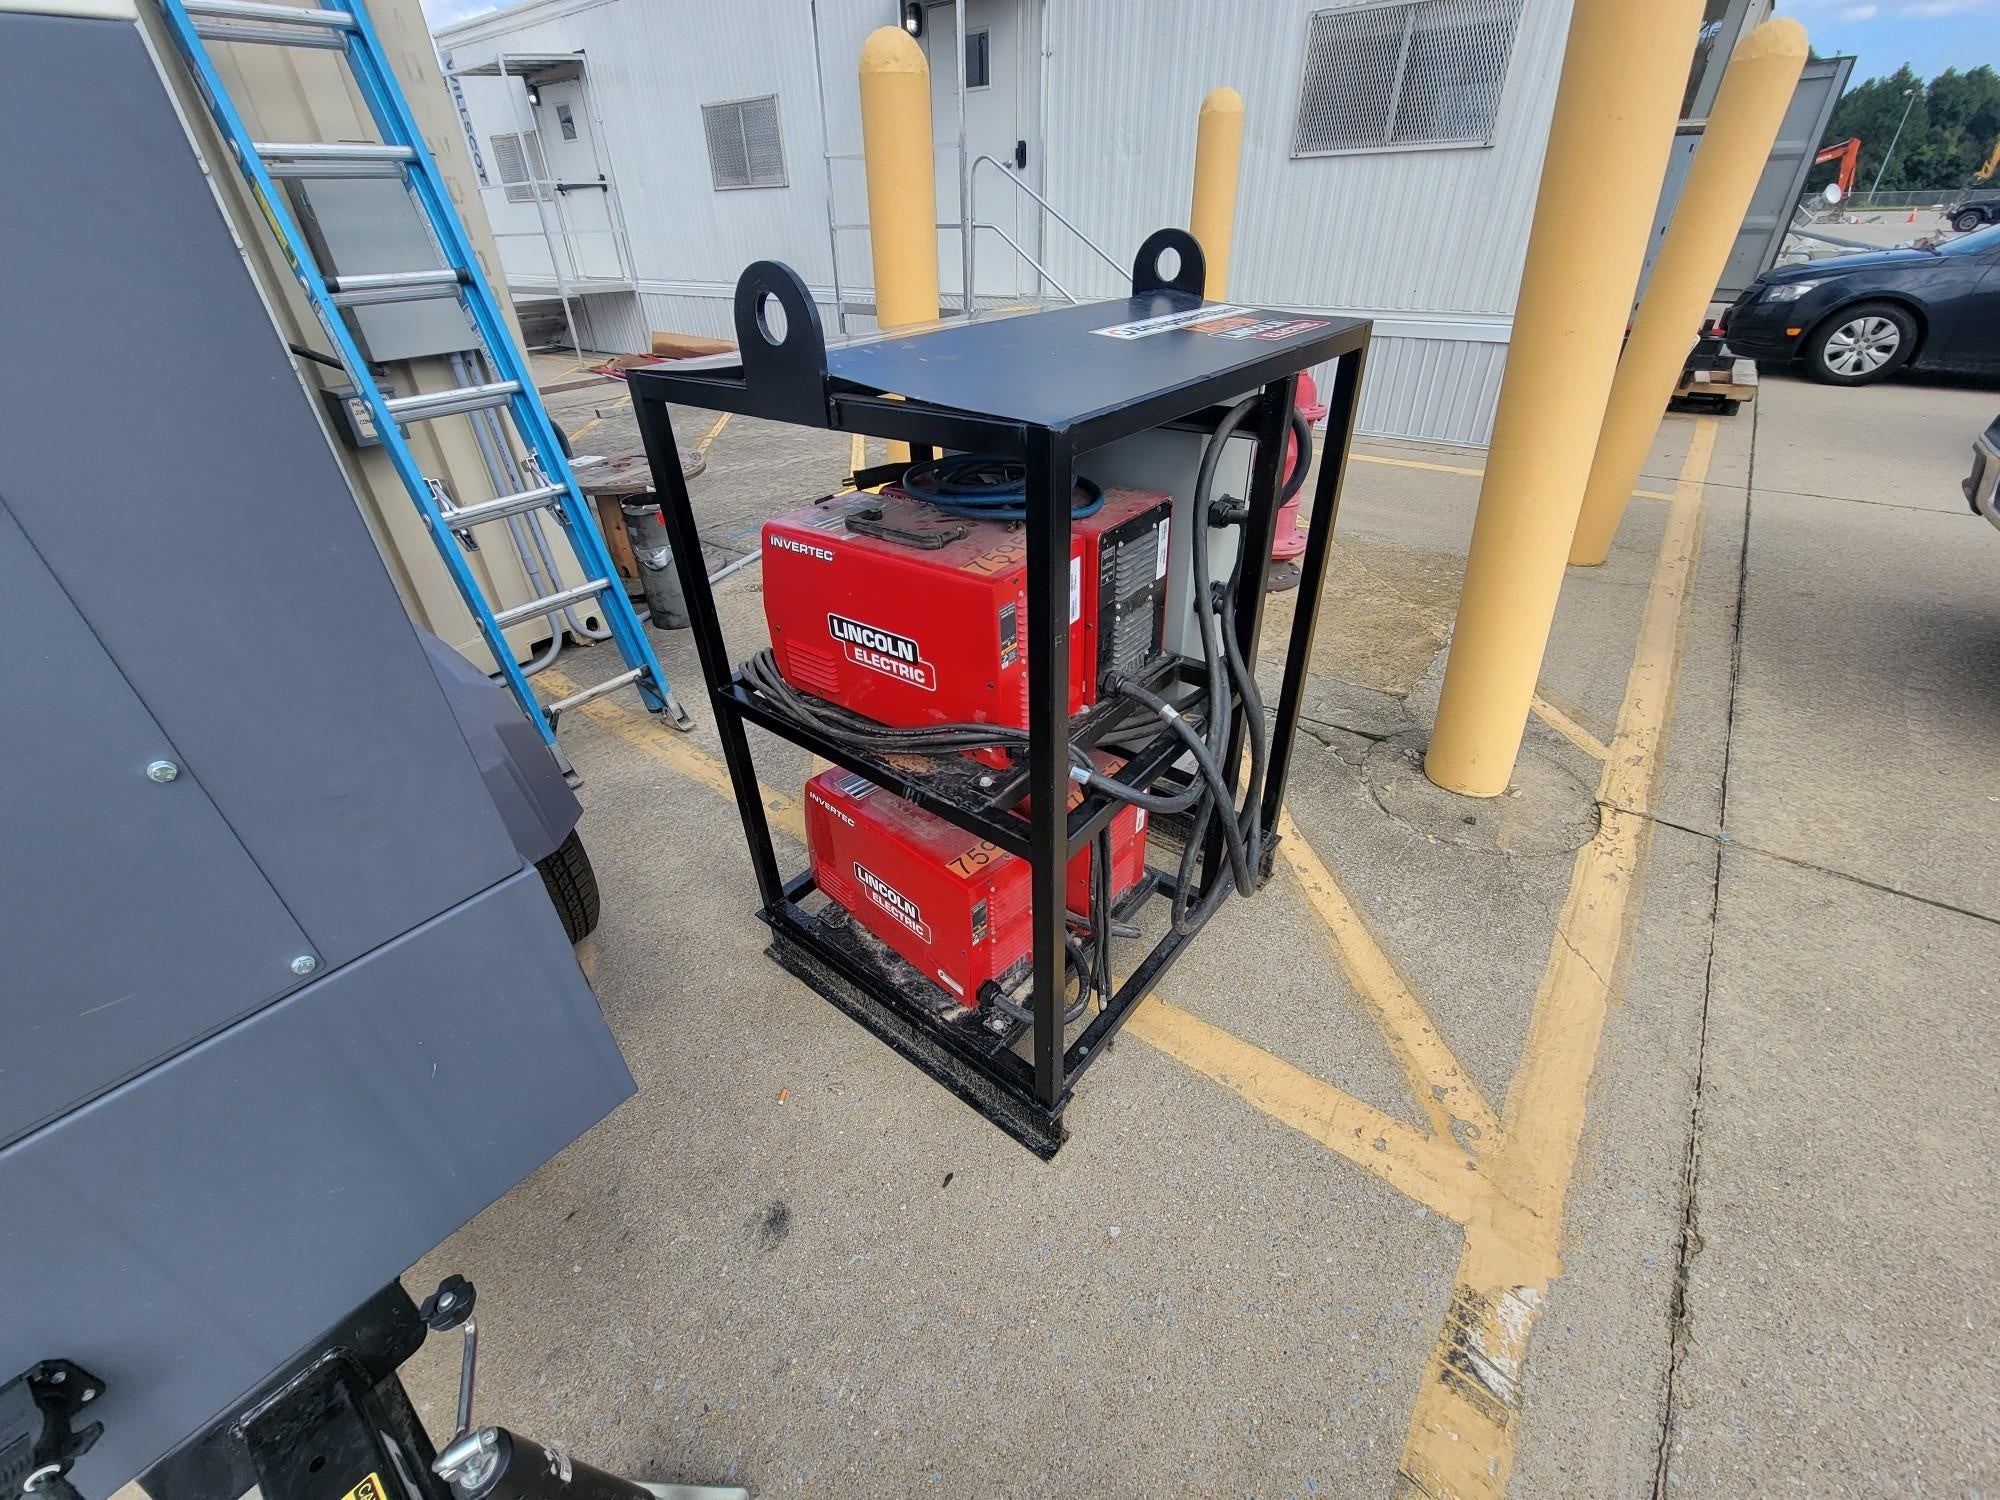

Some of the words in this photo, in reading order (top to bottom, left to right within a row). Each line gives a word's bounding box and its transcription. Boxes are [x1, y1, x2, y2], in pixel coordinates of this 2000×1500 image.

[770, 535, 833, 561] INVERTEC
[832, 618, 913, 662] LINCOLN
[854, 647, 926, 684] ELECTRIC
[809, 791, 855, 827] INVERTEC
[857, 866, 916, 919] LINCOLN
[872, 891, 924, 936] ELECTRIC
